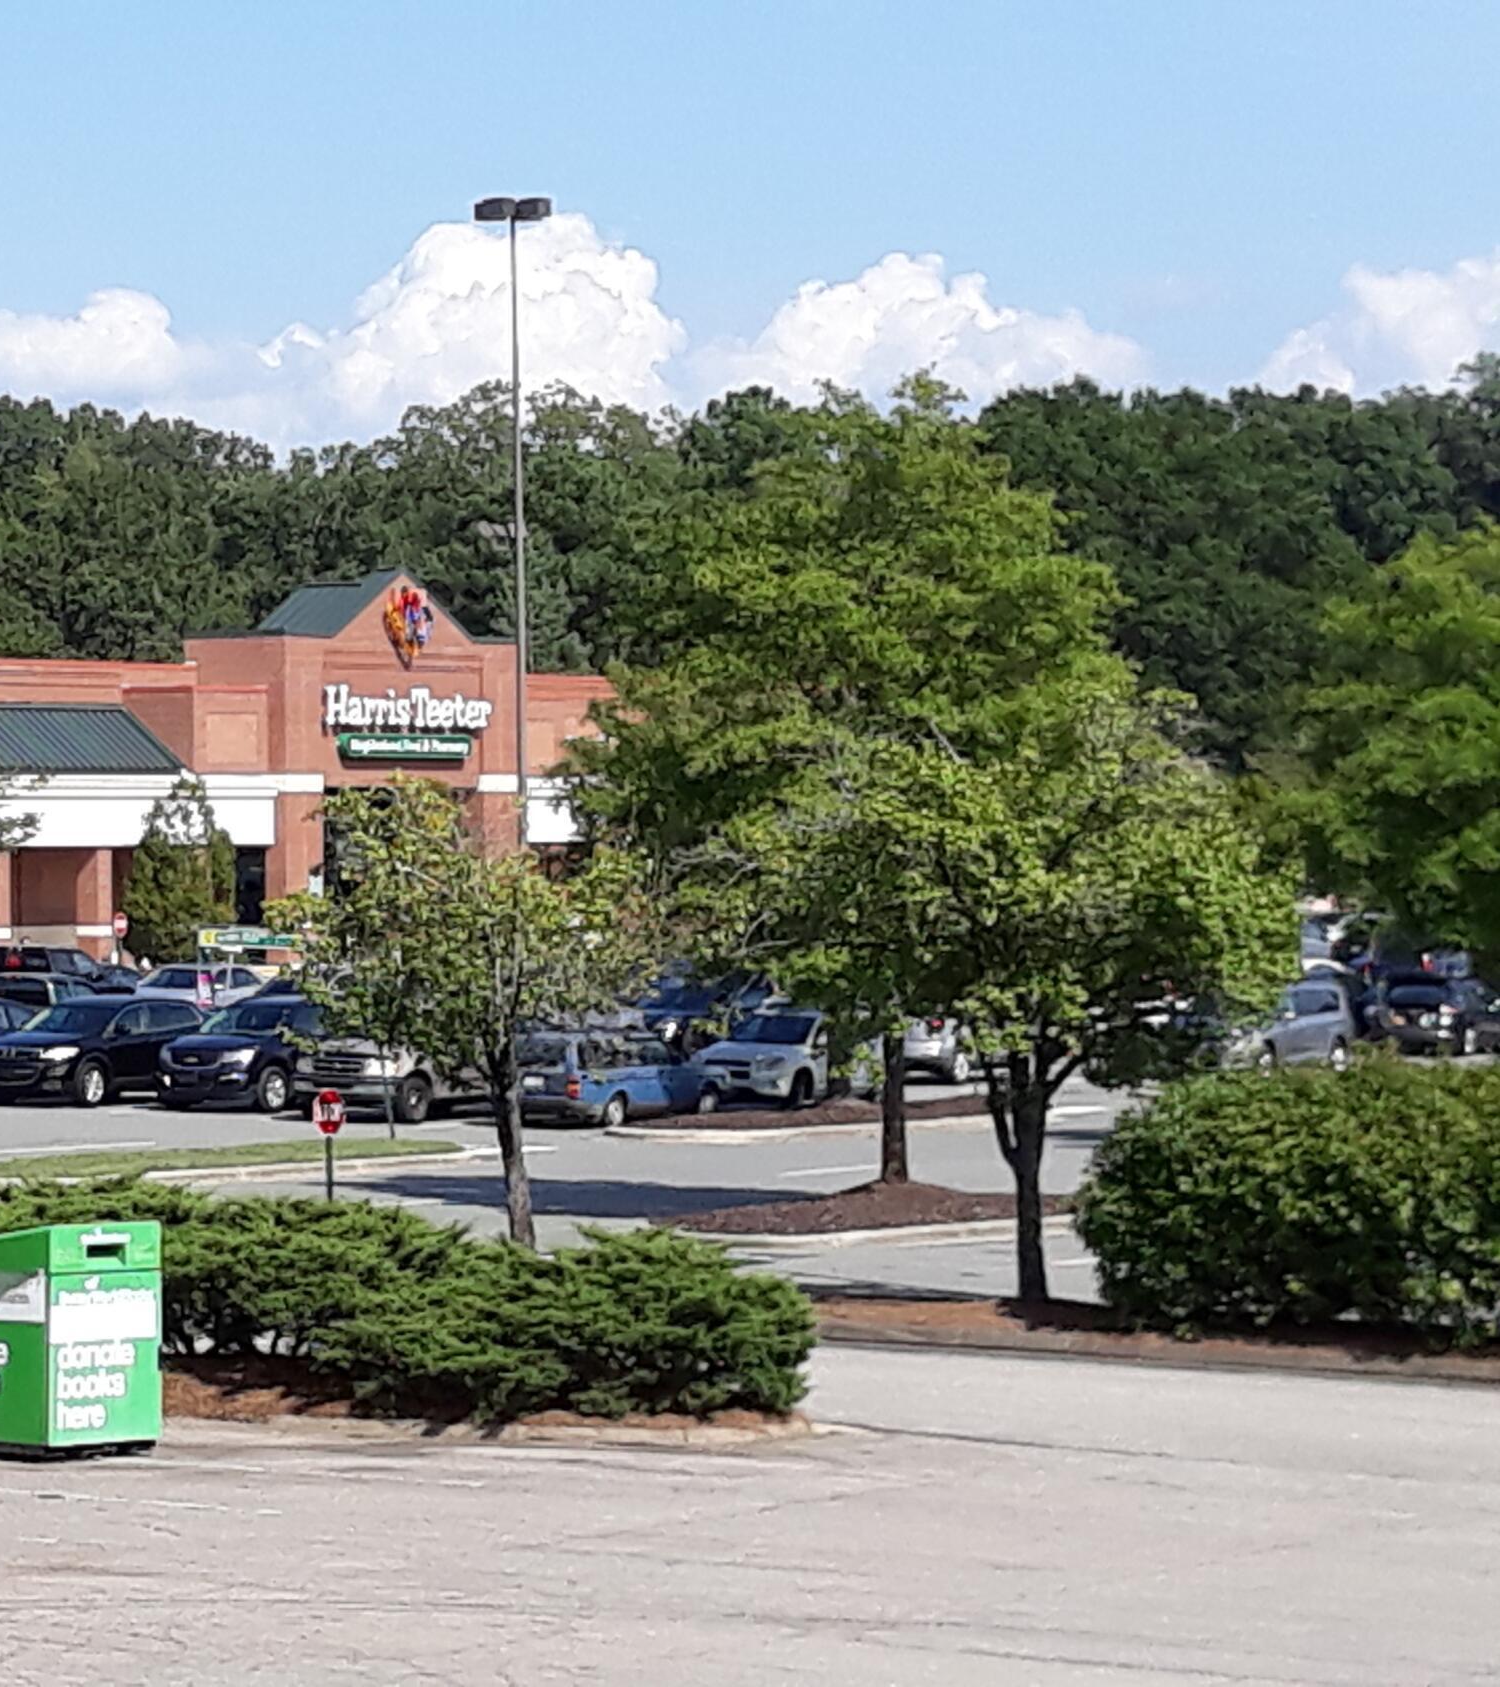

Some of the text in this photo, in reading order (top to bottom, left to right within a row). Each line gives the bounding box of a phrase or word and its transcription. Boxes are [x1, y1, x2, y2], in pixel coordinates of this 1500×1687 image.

[324, 684, 492, 729] Harris Teeter
[57, 1337, 136, 1369] donate
[56, 1368, 126, 1399] books
[56, 1399, 107, 1430] here
